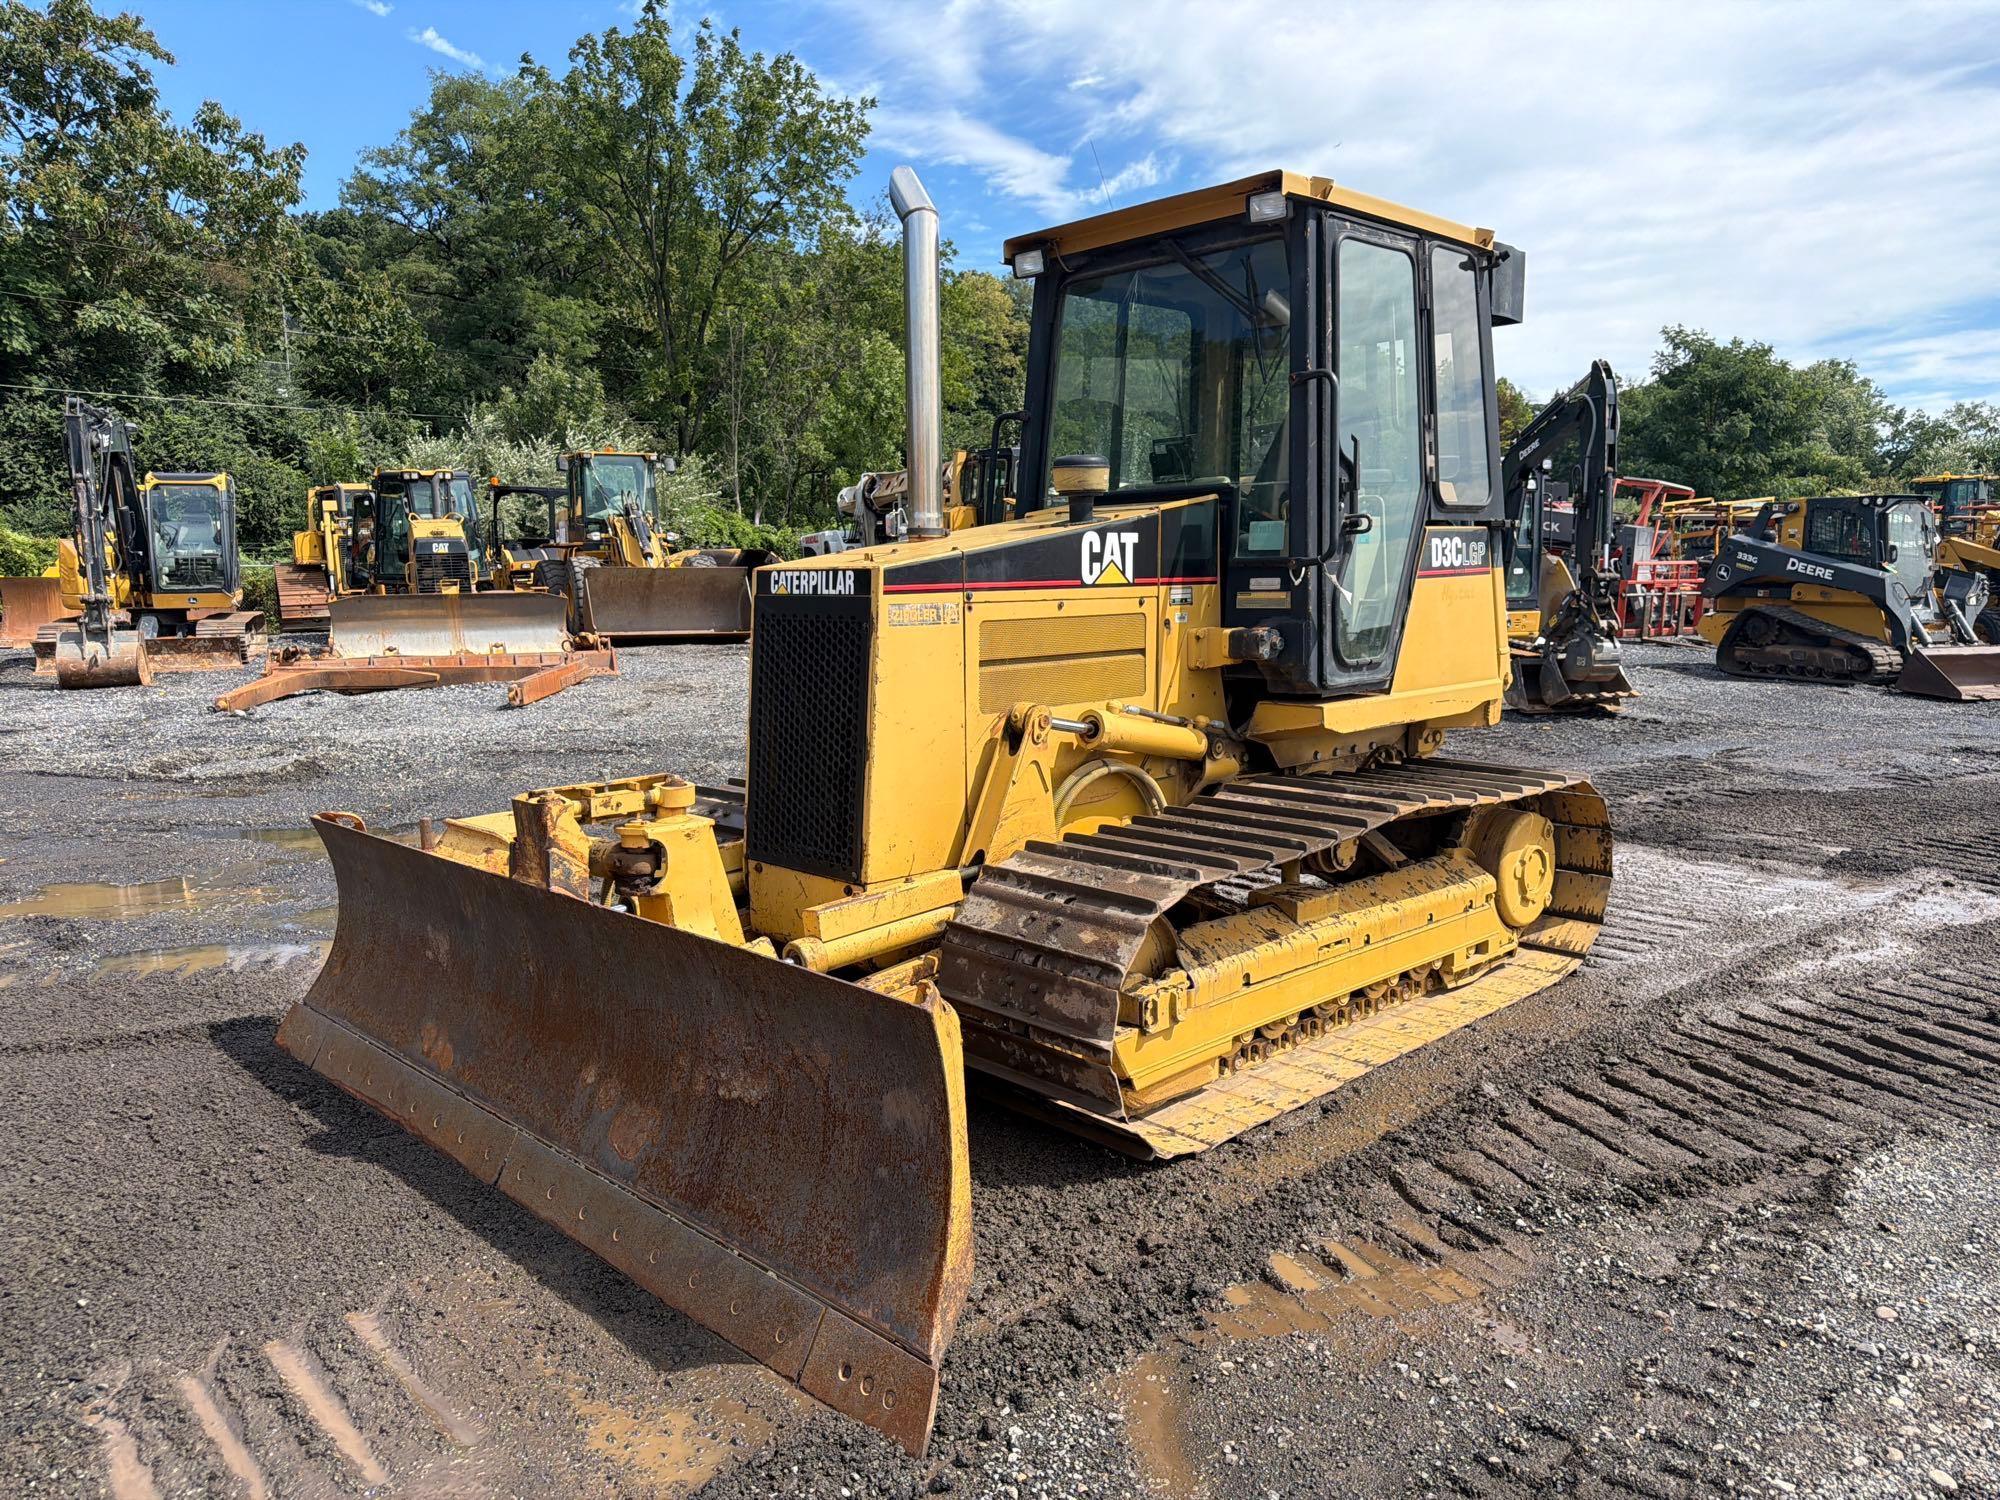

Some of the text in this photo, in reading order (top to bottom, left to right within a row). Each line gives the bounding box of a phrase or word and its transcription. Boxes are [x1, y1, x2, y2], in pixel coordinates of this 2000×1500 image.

[432, 542, 449, 553] CAT
[1081, 530, 1139, 585] CAT
[1736, 551, 1758, 564] 333G
[1786, 557, 1834, 581] DEERE
[770, 570, 855, 595] CATERPILLAR
